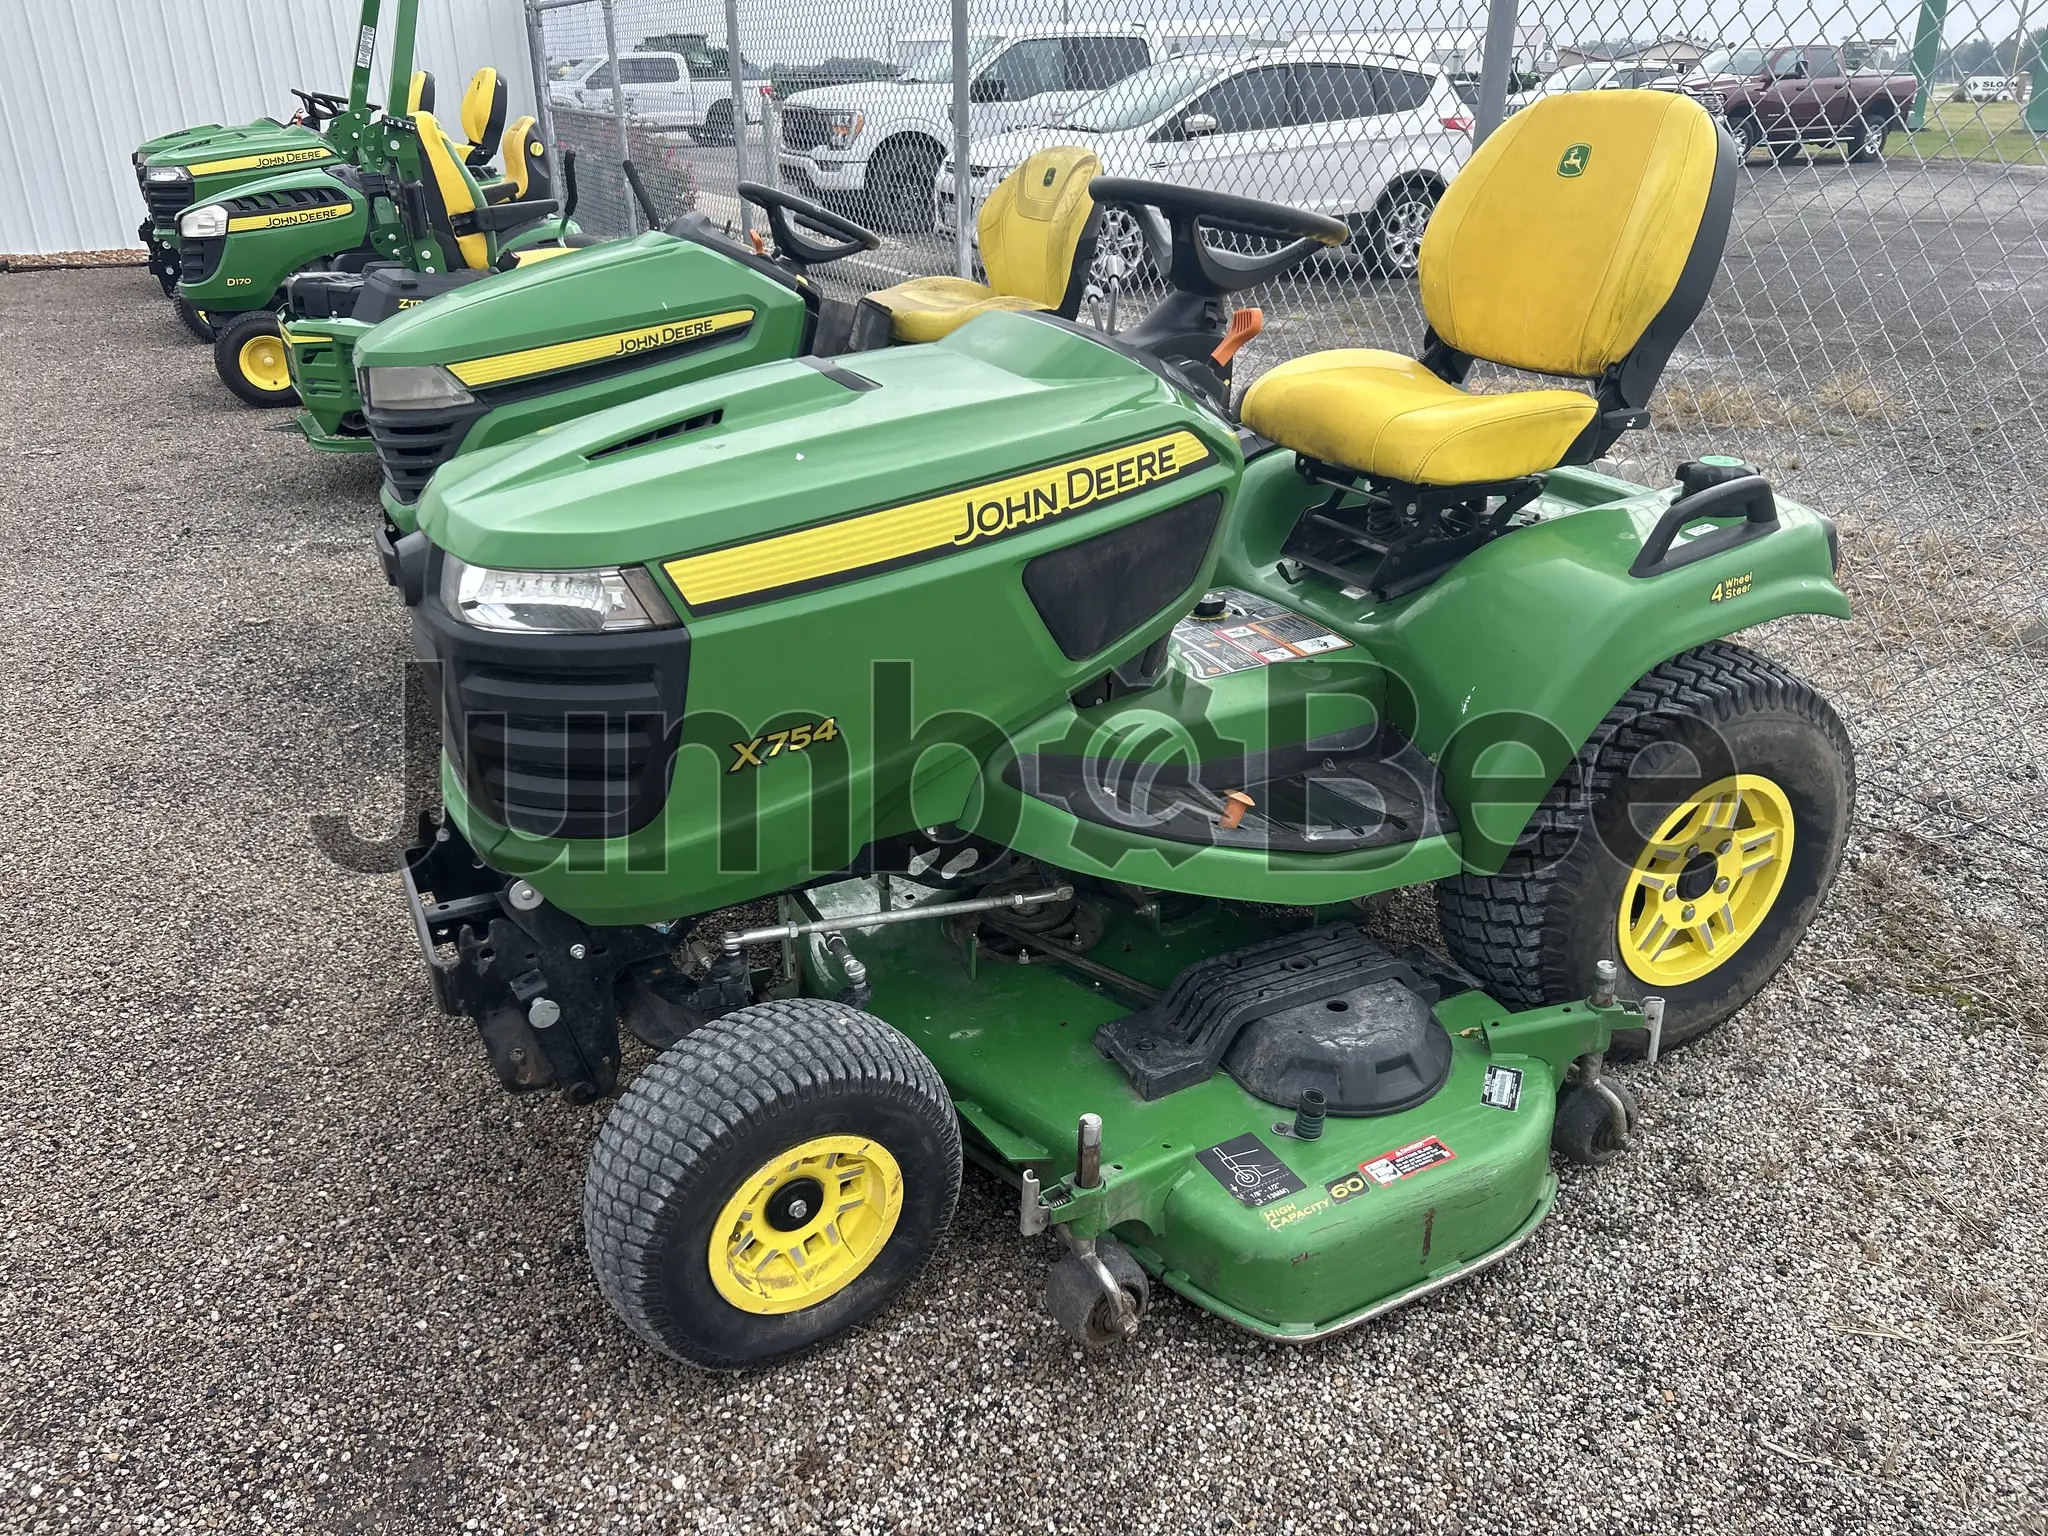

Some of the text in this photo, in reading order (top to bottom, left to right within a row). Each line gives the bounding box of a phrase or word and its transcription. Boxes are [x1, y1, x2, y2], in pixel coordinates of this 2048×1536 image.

[256, 150, 321, 168] JOHN DEERE
[266, 208, 338, 228] JOHN DEERE
[226, 277, 252, 287] D170
[616, 320, 714, 355] JOHN DEERE
[953, 443, 1179, 544] JOHN DEERE
[1710, 570, 1753, 602] 4 Wheel
[1725, 583, 1752, 600] Steer
[727, 716, 839, 773] X754
[1331, 1177, 1364, 1199] 60
[1263, 1202, 1297, 1221] HIGH
[1269, 1197, 1330, 1229] CAPACITY
